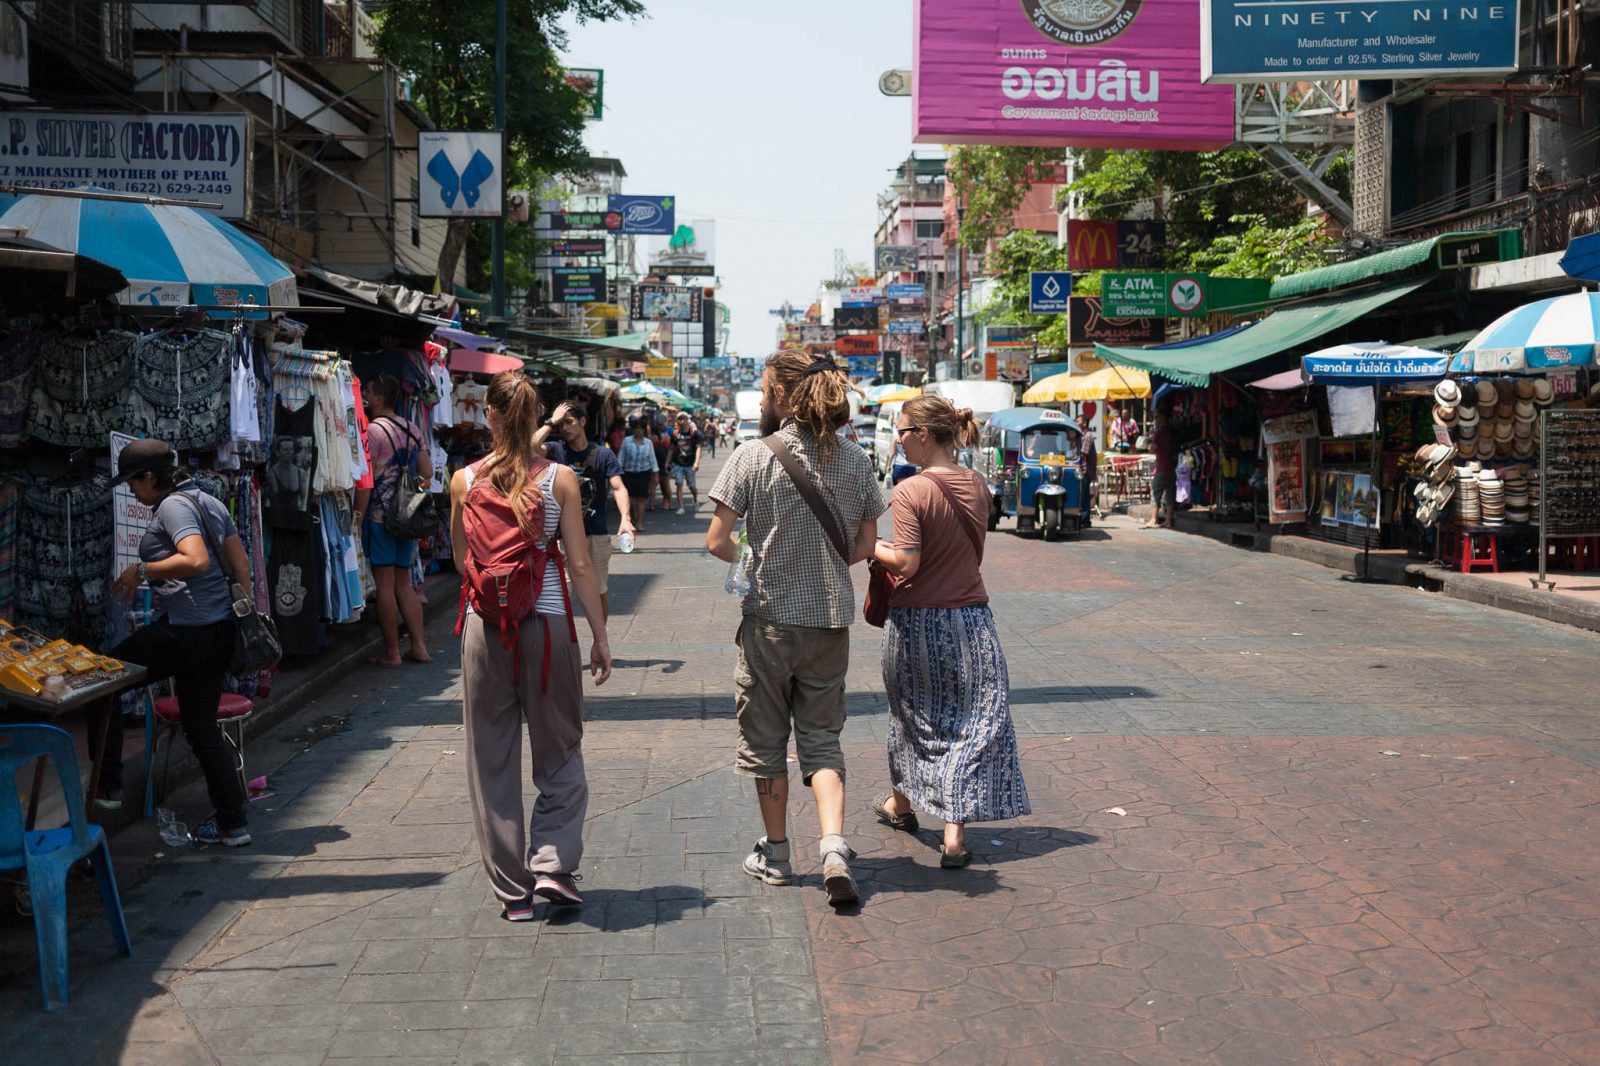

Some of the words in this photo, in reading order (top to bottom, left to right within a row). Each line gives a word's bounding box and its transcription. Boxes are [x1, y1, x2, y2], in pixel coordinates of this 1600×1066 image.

[1234, 10, 1378, 27] NINETY
[1413, 6, 1504, 21] NINE
[1298, 36, 1358, 48] Manufacturer
[1363, 36, 1380, 47] and
[1386, 34, 1436, 46] Wholesaler
[1001, 47, 1047, 60] ธนาคาร
[1264, 56, 1288, 67] Made
[1293, 56, 1302, 66] to
[1306, 56, 1329, 66] order
[1334, 55, 1343, 65] of
[1348, 53, 1376, 65] 92.5%
[1382, 52, 1414, 65] Sterling
[1418, 51, 1443, 63] Silver
[1447, 51, 1480, 63] Jewelry
[1001, 58, 1159, 103] ออมสิน
[1001, 104, 1080, 119] Government
[1080, 107, 1127, 122] Savings
[1127, 109, 1159, 122] Bank
[36, 118, 117, 159] SILVER
[120, 120, 240, 168] (FACTORY)
[15, 166, 92, 178] MARCASITE
[97, 167, 154, 180] MOTHER
[156, 169, 178, 180] OF
[183, 170, 230, 182] PEARL
[125, 181, 162, 195] (622)
[166, 183, 232, 196] 629-2449
[1125, 233, 1152, 254] 24
[1123, 277, 1154, 290] ATM
[1312, 361, 1352, 373] สะอาดใส
[1355, 359, 1391, 373] มั่นใจได้
